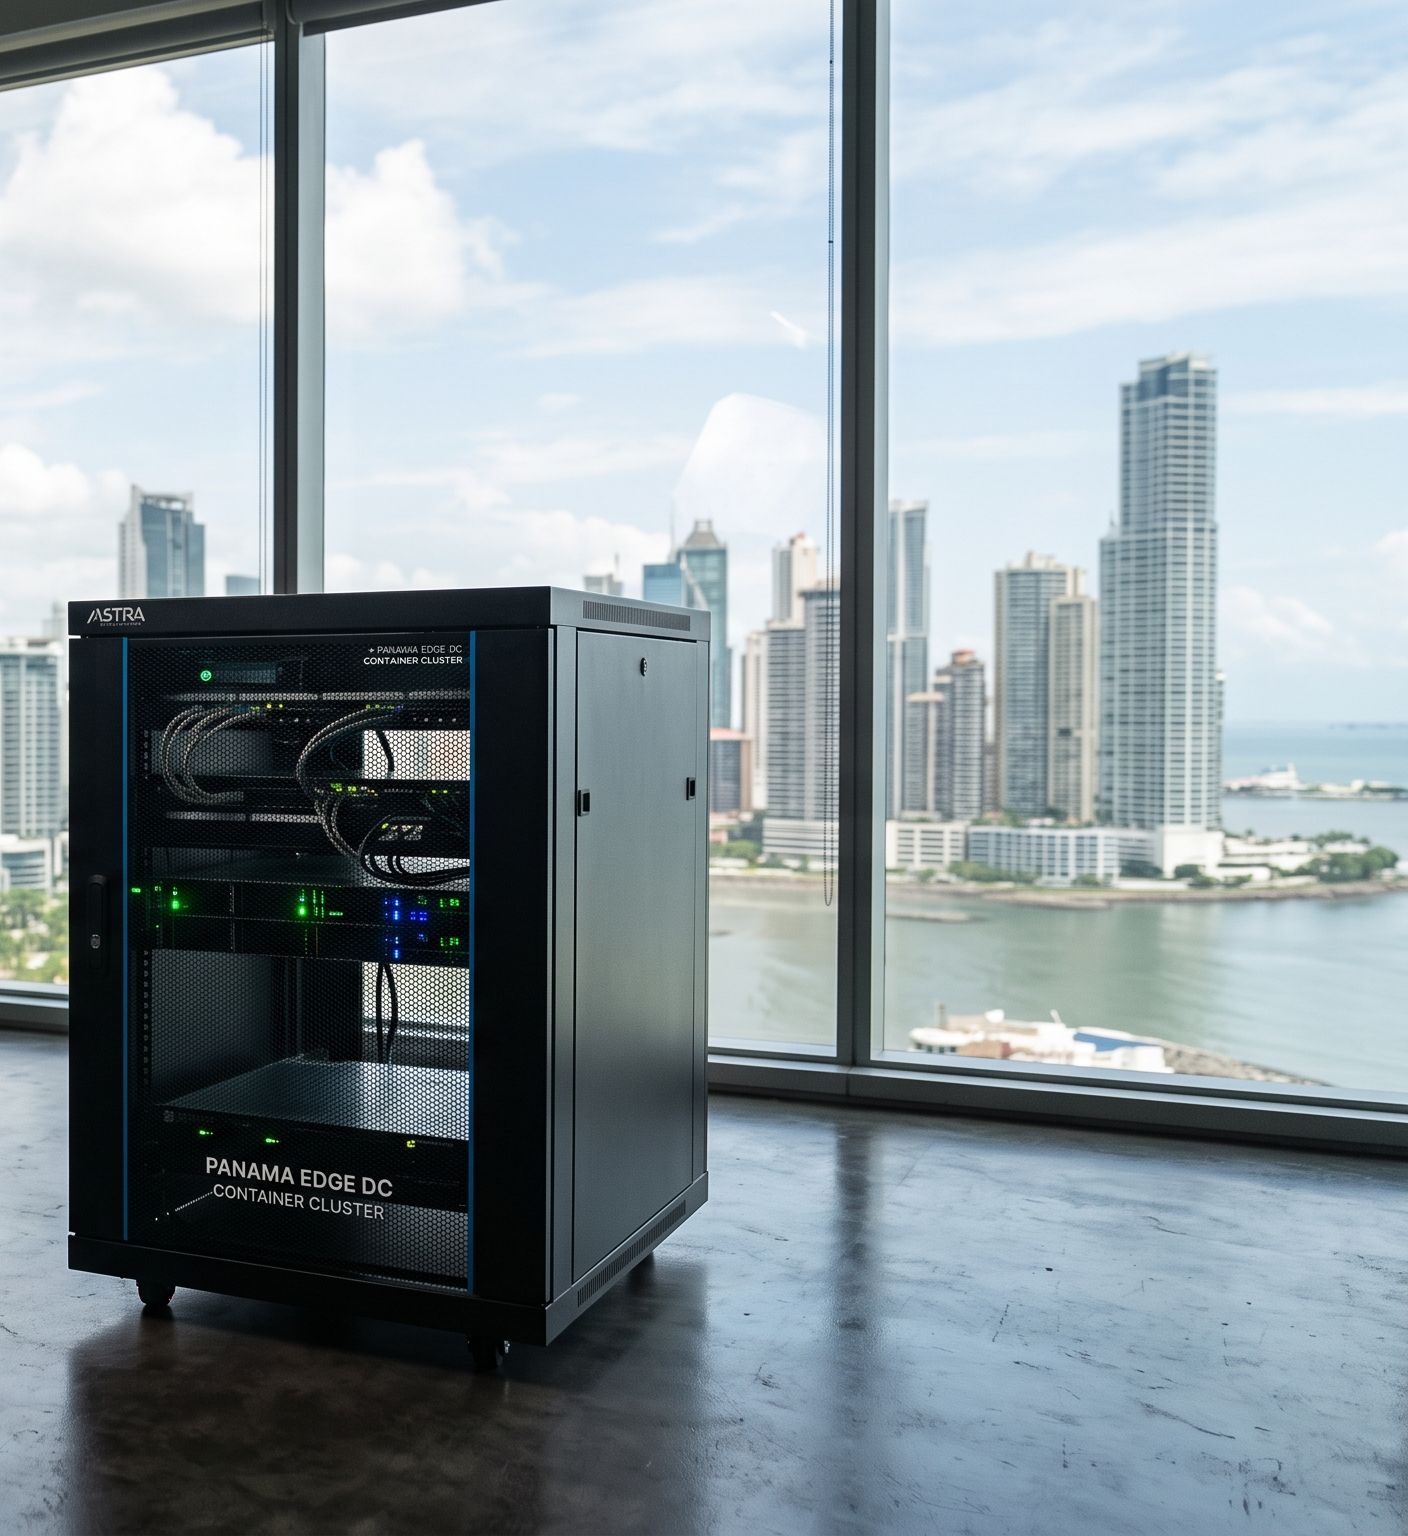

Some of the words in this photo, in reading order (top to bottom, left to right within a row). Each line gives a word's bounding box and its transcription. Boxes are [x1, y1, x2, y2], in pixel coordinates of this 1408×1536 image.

[86, 606, 146, 624] ASTRA
[421, 645, 446, 654] EDGE
[449, 644, 463, 654] DC
[363, 656, 419, 665] CONTAINER
[420, 656, 463, 665] CLUSTER
[205, 1155, 296, 1186] PANAMA
[299, 1168, 357, 1194] EDGE
[361, 1175, 394, 1198] DC
[212, 1182, 306, 1210] CONTAINER
[308, 1196, 385, 1221] CLUSTER
